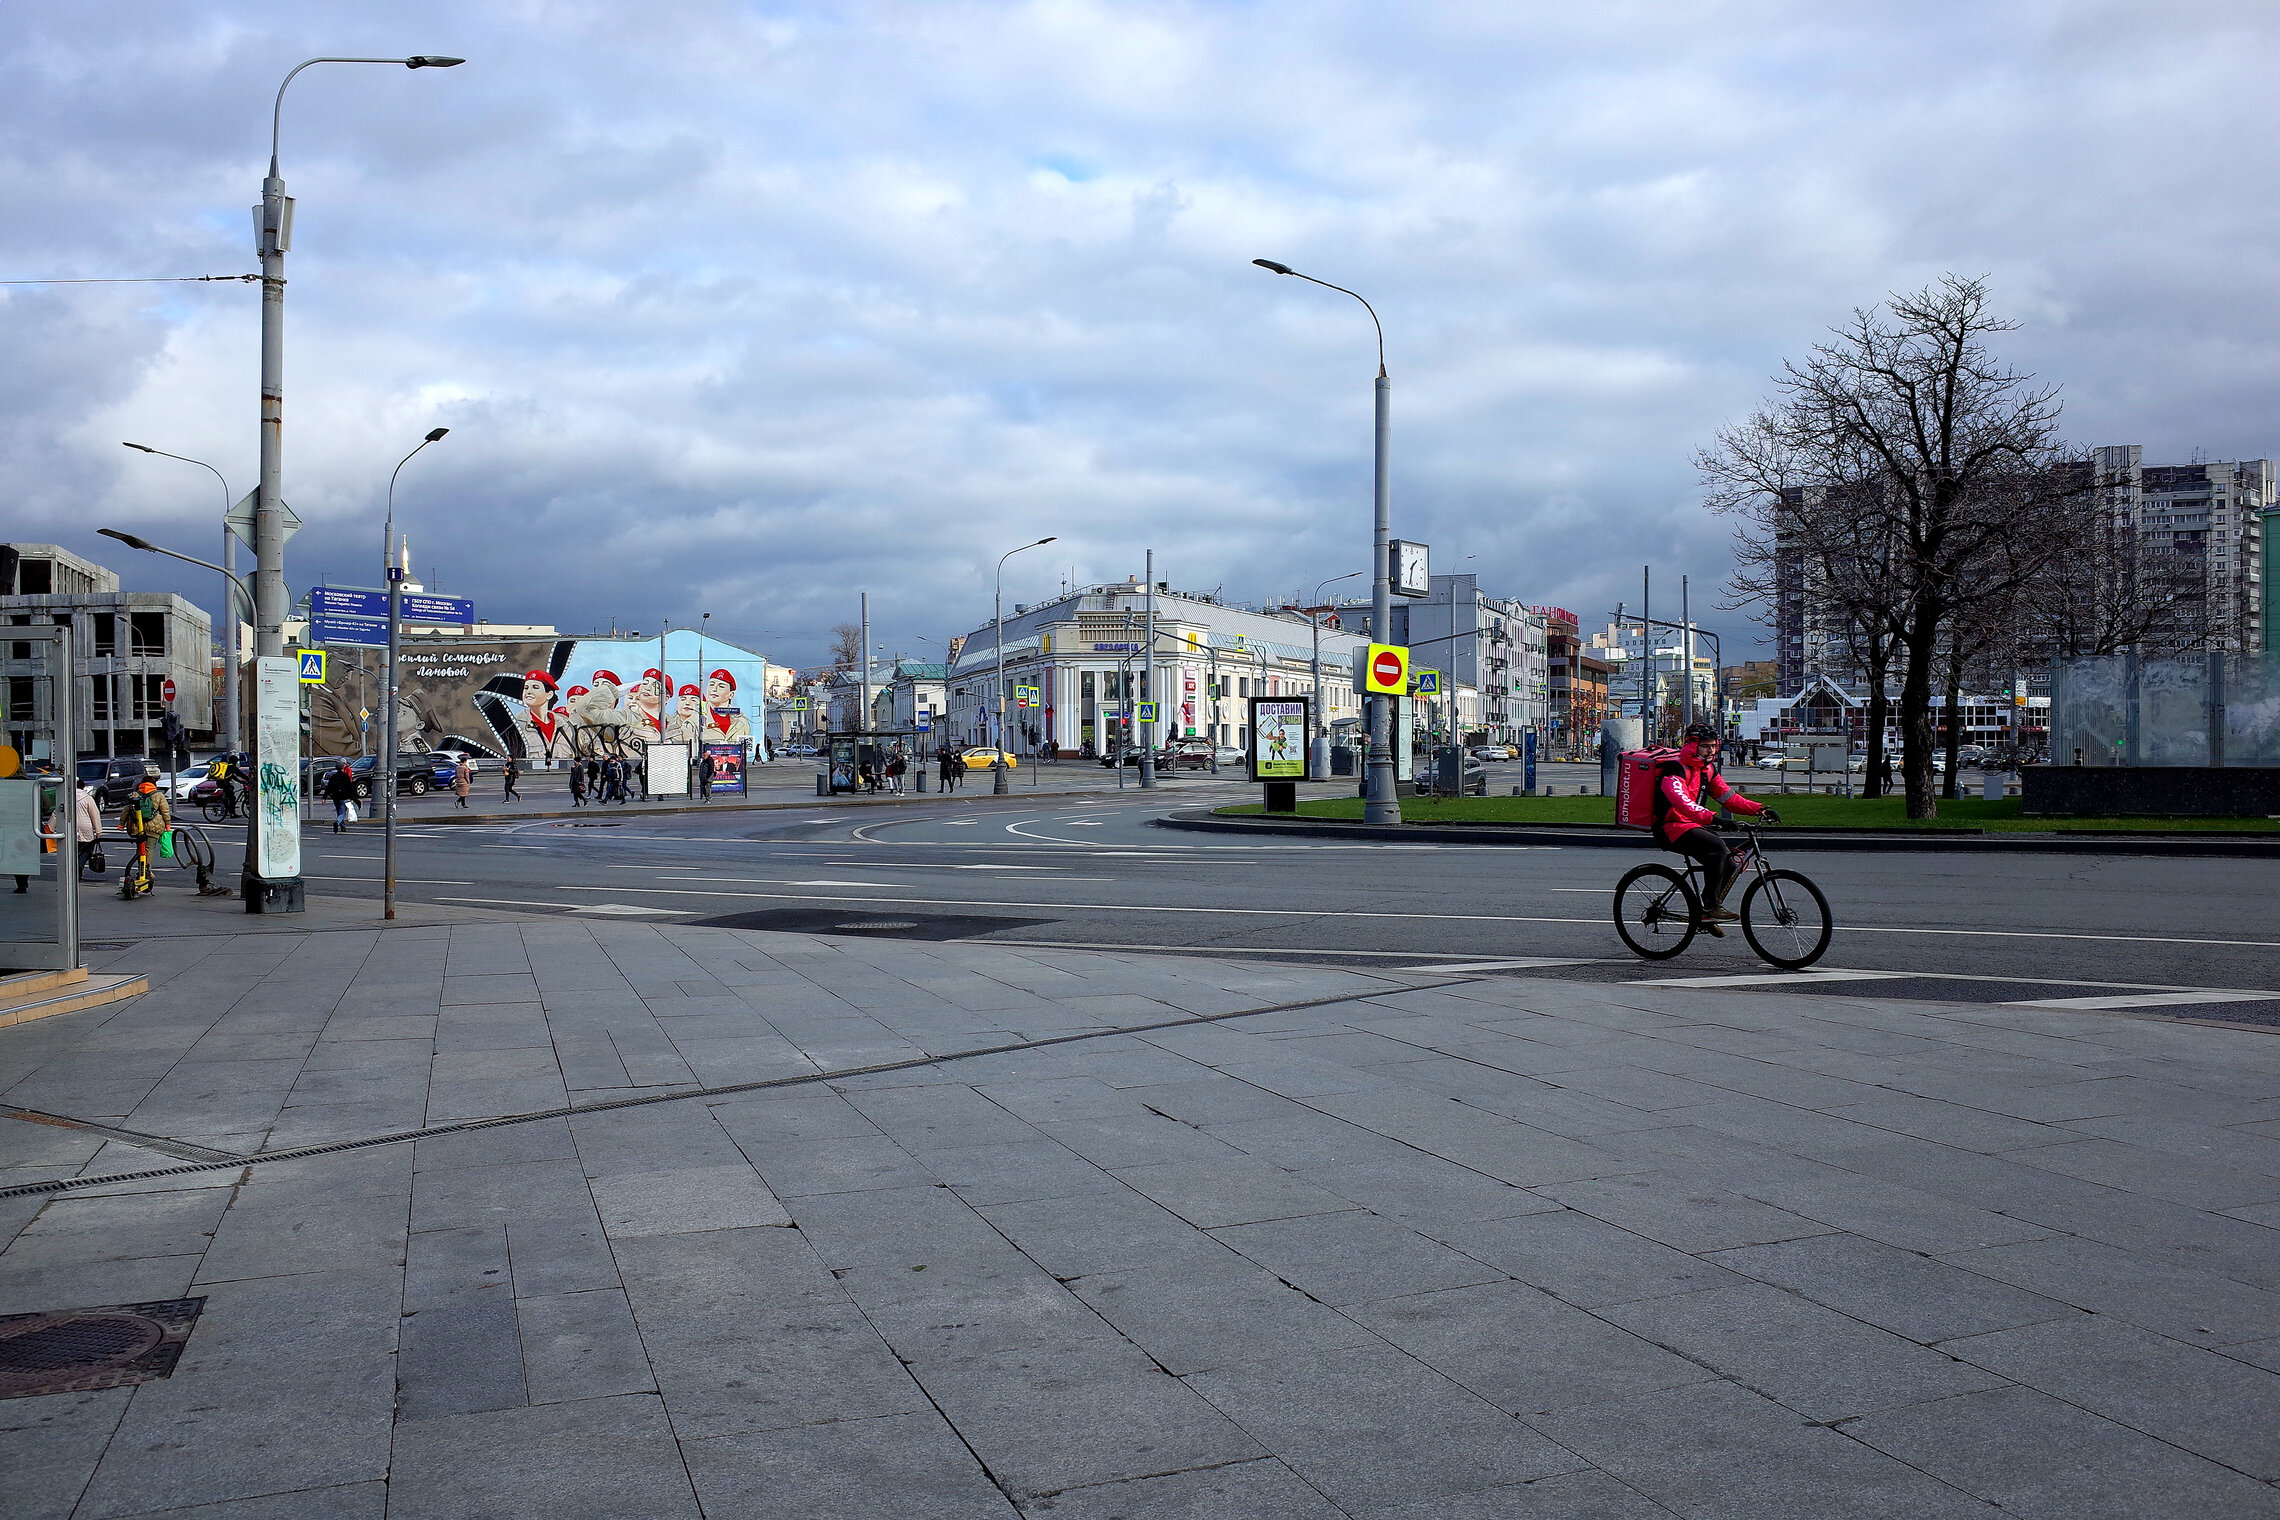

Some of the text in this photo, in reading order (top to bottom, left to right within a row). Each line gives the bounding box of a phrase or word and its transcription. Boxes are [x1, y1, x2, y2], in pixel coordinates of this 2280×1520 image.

[399, 652, 507, 664] силий Семенович
[416, 665, 470, 677] Лановой
[1260, 704, 1302, 716] ДОСТАВИМ
[1286, 716, 1302, 725] ЧАСА
[1621, 763, 1631, 822] samokat.ru
